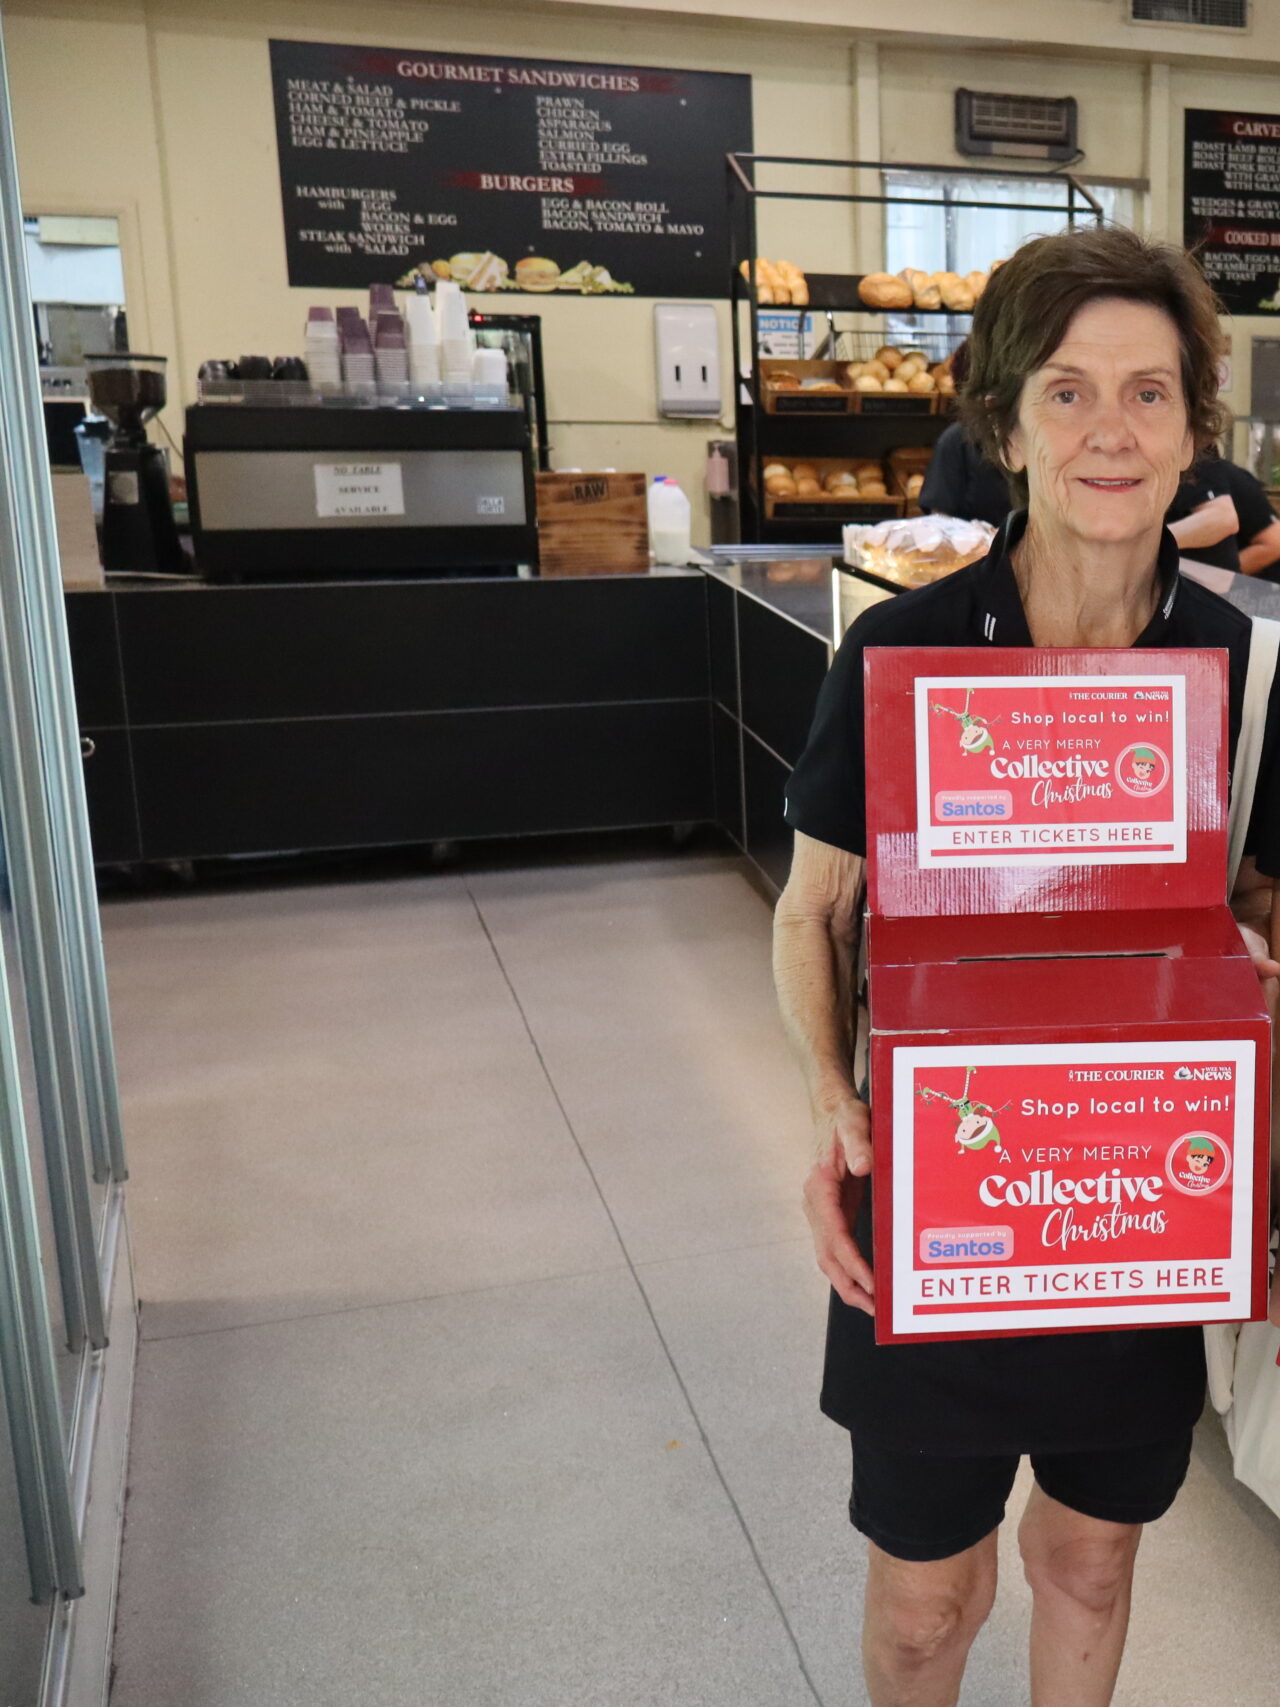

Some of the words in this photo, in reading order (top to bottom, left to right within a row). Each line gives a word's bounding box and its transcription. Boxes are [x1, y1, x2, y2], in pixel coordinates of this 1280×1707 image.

[397, 61, 504, 82] GOURMET
[507, 68, 640, 92] SANDWICHES
[288, 91, 352, 104] CORNED
[355, 95, 393, 107] BEEF
[396, 98, 407, 109] &
[410, 99, 462, 112] PICKLE
[536, 95, 584, 108] PRAWN
[536, 106, 600, 119] CHICKEN
[538, 118, 612, 132] ASPARAGUS
[538, 129, 595, 141] SALMON
[292, 136, 323, 148] EGG
[326, 138, 337, 149] &
[341, 139, 408, 153] LETTUCE
[539, 140, 600, 153] CURRIED
[602, 142, 631, 154] EGG
[540, 151, 587, 163] EXTRA
[588, 153, 648, 165] FILLINGS
[541, 161, 602, 174] TOASTED
[480, 173, 575, 193] BURGERS
[297, 185, 398, 200] HAMBURGERS
[318, 200, 345, 210] with
[361, 201, 391, 212] EGG
[361, 211, 410, 223] BACON
[414, 214, 424, 224] &
[428, 214, 457, 226] EGG
[597, 221, 651, 234] TOMATO
[653, 223, 664, 234] &
[667, 224, 704, 235] MAYO
[299, 230, 346, 243] STEAK
[348, 232, 425, 246] SANDWICH
[1224, 231, 1269, 246] COOKED
[325, 244, 352, 254] with
[364, 245, 409, 256] SALAD
[1072, 692, 1090, 700] THE
[1091, 692, 1128, 700] COURIER
[1011, 712, 1055, 727] Shop
[1062, 712, 1104, 724] local
[1111, 712, 1128, 723] to
[1135, 711, 1169, 723] win!
[1003, 740, 1011, 750] A
[1016, 740, 1050, 750] VERY
[1056, 739, 1101, 750] MERRY
[990, 754, 1109, 779] Collective
[1031, 778, 1113, 808] Christmas
[942, 801, 1005, 816] Santos
[952, 831, 1012, 845] ENTER
[1020, 828, 1100, 843] TICKETS
[1108, 827, 1153, 841] HERE
[1075, 1070, 1102, 1082] THE
[1105, 1069, 1165, 1081] COURIER
[1193, 1068, 1232, 1081] News
[1021, 1098, 1080, 1119] Shop
[1090, 1096, 1145, 1114] local
[1152, 1096, 1175, 1113] to
[1185, 1095, 1230, 1112] win!
[999, 1149, 1012, 1164] A
[1021, 1146, 1074, 1163] VERY
[1083, 1145, 1152, 1160] MERRY
[979, 1168, 1164, 1207] Collective
[1040, 1203, 1168, 1251] Christmas
[928, 1240, 1005, 1258] Santos
[921, 1276, 1011, 1298] ENTER
[1024, 1270, 1143, 1293] TICKETS
[1156, 1267, 1224, 1288] HERE
